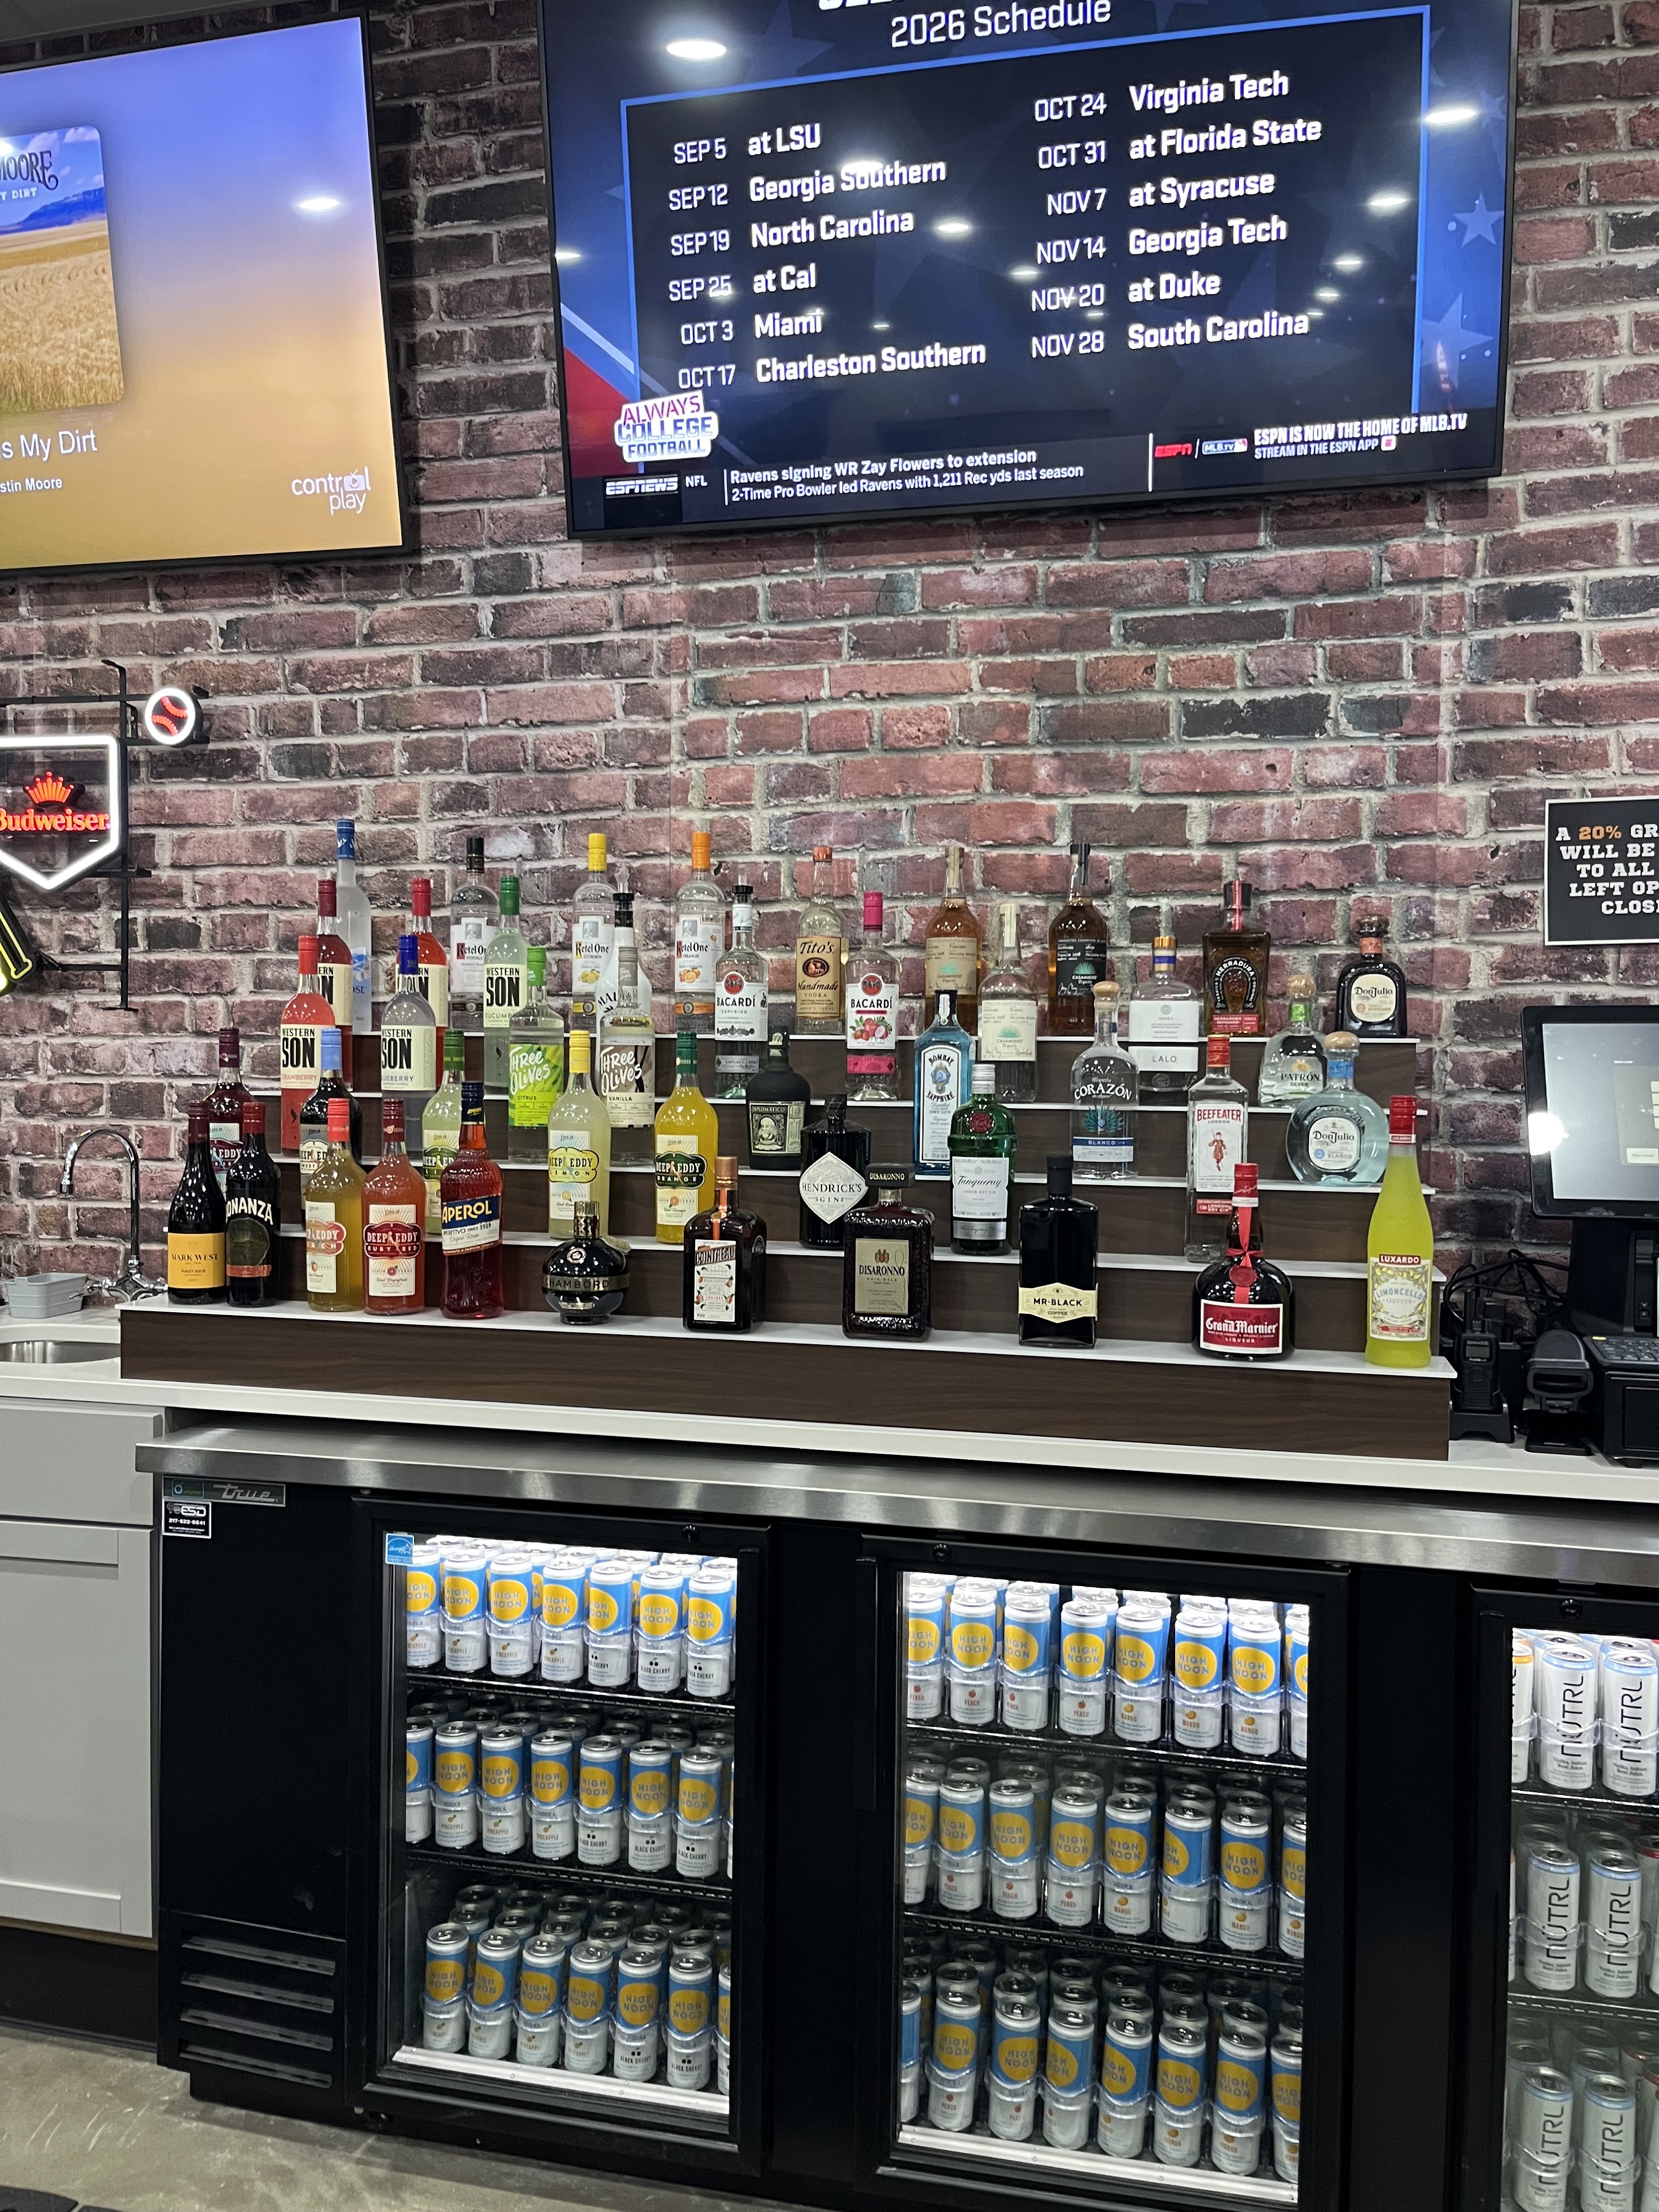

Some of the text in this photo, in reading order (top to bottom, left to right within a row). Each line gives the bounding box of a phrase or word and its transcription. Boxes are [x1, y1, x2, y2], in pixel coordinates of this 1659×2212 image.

[892, 0, 1111, 48] 2026 Schedule
[1035, 70, 1289, 123] OCT 24 Virginia Tech
[674, 122, 822, 165] SEP 5 at LSU
[1038, 118, 1322, 169] OCT 31 at Florida State
[12, 187, 38, 199] DIRT
[669, 160, 947, 211] SEP 12 Georgia Southern
[1047, 173, 1276, 216] NOV 7 at Syracuse
[670, 208, 915, 257] SEP 19 North Carolina
[1036, 214, 1287, 265] NOV 14 Georgia Tech
[669, 262, 817, 302] SEP 25 at Cal
[1031, 270, 1221, 312] NOV 20 at Duke
[680, 309, 823, 346] OCT 3 Miami
[1031, 311, 1310, 358] NOV 28 South Carolina
[678, 342, 987, 390] OCT 17 Charleston Southern
[623, 394, 701, 426] ALWAYS
[618, 416, 713, 443] COLLEGE
[1253, 412, 1468, 446] ESPN IS NOW THE HOME OF MLB.TV
[19, 433, 51, 462] My
[58, 429, 98, 454] Dirt
[628, 439, 706, 458] FOOTBALL
[1154, 442, 1193, 458] ESPN
[1254, 437, 1379, 460] STREAM IN THE ESPN APP
[730, 448, 1037, 484] Ravens signing WR Zay Flowers to extension
[25, 477, 63, 491] Moore
[685, 474, 708, 488] NFL
[731, 465, 1084, 502] 2-Time Pro Bowler led Ravens with 1,211 Rec yds last season
[328, 487, 367, 515] play
[1555, 825, 1622, 841] A 20%
[1559, 842, 1655, 860] WILL BE
[1576, 861, 1655, 878] TO ALL
[1569, 881, 1625, 897] LEFT
[676, 940, 709, 959] Ketel One
[800, 941, 835, 955] Tito's
[486, 967, 520, 977] WESTERN
[1215, 960, 1255, 977] HERRADURA
[486, 976, 520, 1008] SON
[797, 979, 839, 992] Handmade
[717, 995, 757, 1008] BACARDÍ
[928, 1053, 955, 1067] BOMBAY
[1280, 1071, 1320, 1083] PATRÓN
[926, 1090, 956, 1103] SAPPHIRE
[1073, 1082, 1133, 1100] CORAZÓN
[1197, 1109, 1241, 1123] BEEFEATER
[677, 1162, 701, 1173] EDDY
[801, 1182, 863, 1193] HENDRICK'S
[957, 1175, 1003, 1188] Tanqueray
[226, 1196, 274, 1225] ONANZA
[442, 1199, 492, 1224] APEROL
[367, 1232, 418, 1243] DEEP EDDY
[171, 1253, 193, 1261] MARK
[1380, 1254, 1420, 1265] LUXARDO
[859, 1264, 905, 1276] DISARONNO
[545, 1278, 609, 1291] CHAMBORD
[1375, 1285, 1424, 1300] LIMONCELLO
[1205, 1317, 1277, 1334] Grand Marnier
[180, 1505, 206, 1517] ESD
[959, 1635, 987, 1644] HIGH
[957, 1645, 989, 1653] NOON
[1182, 1719, 1201, 1729] MANGO
